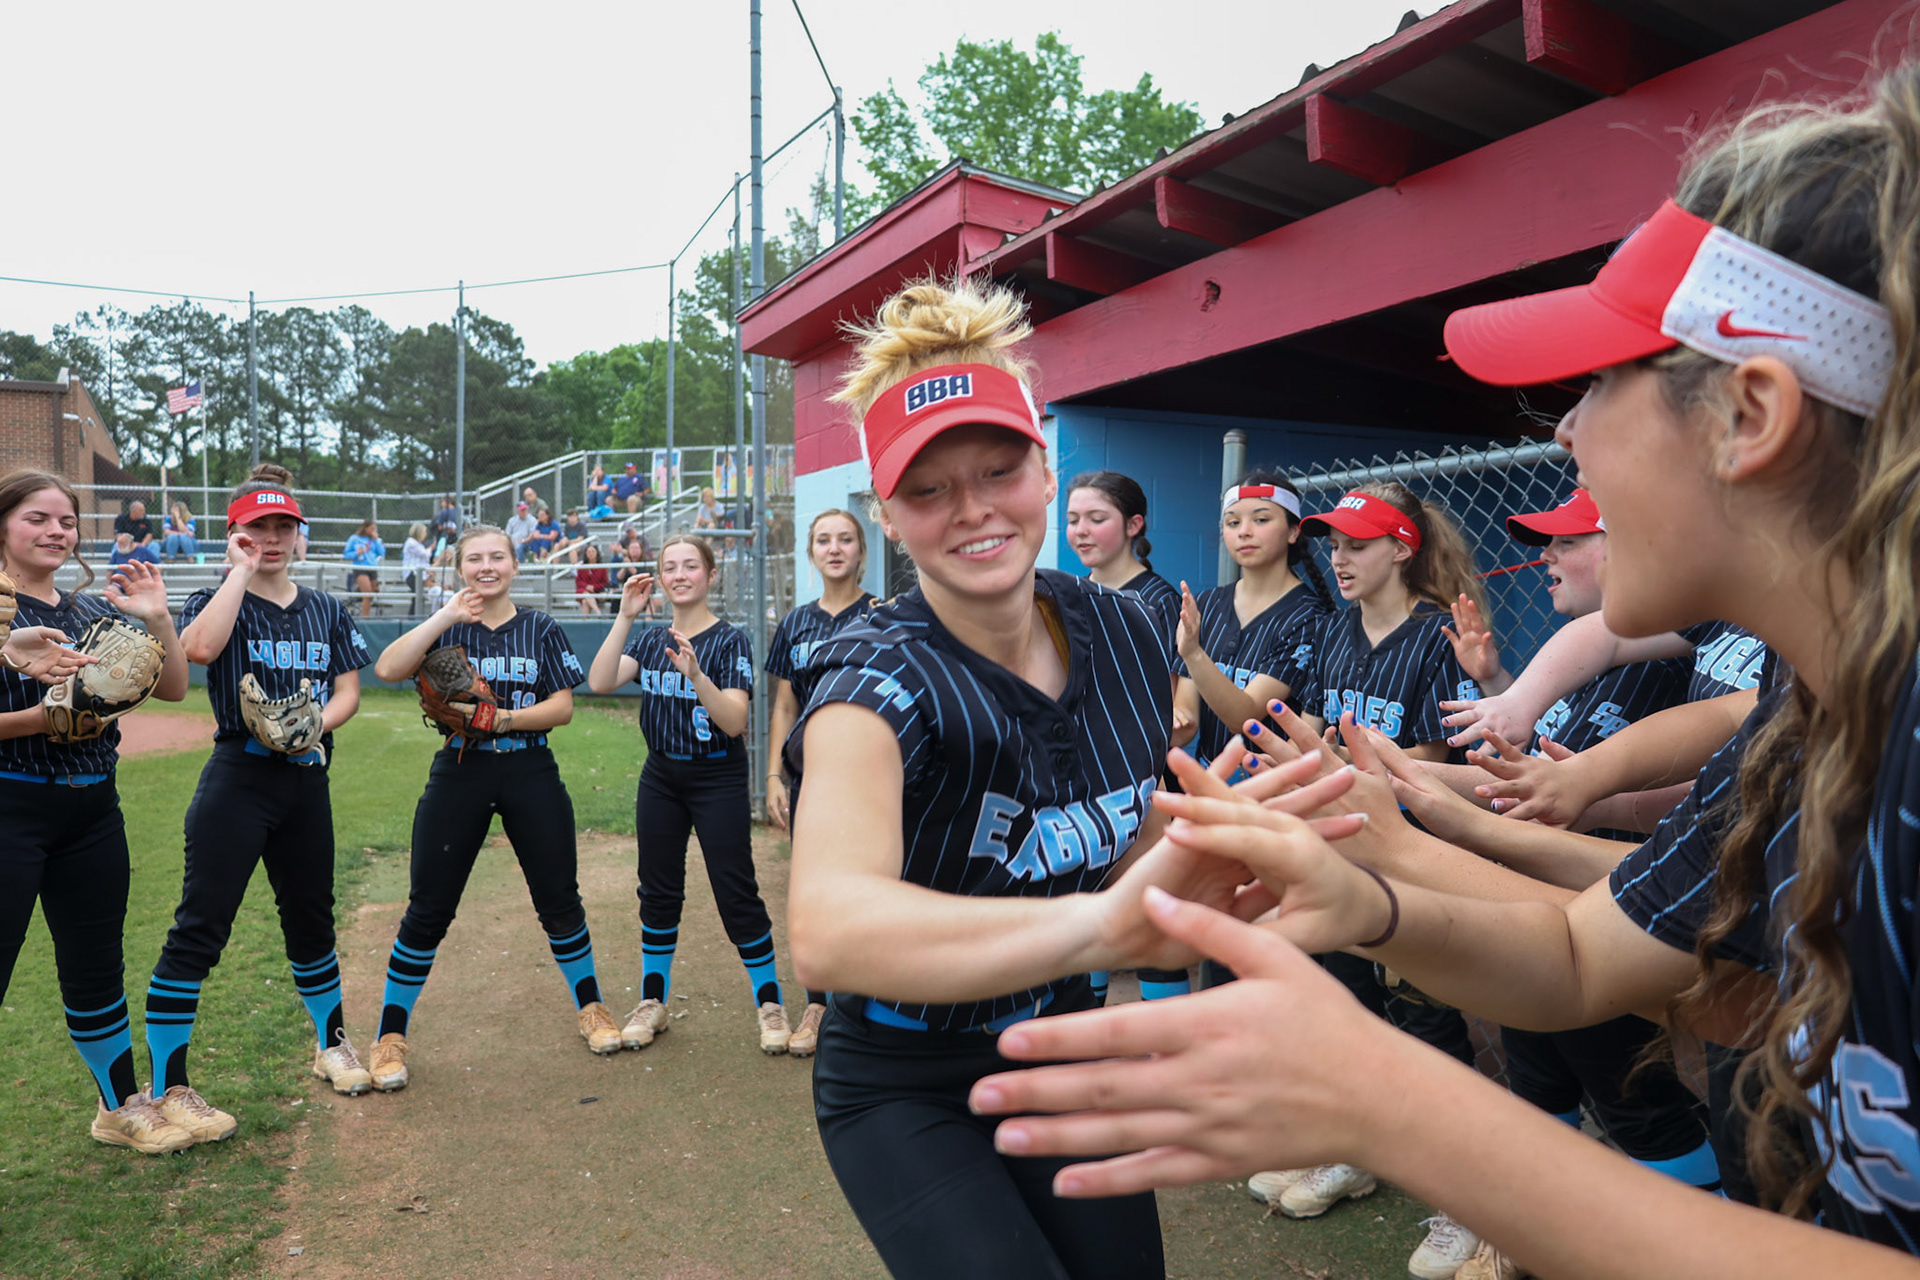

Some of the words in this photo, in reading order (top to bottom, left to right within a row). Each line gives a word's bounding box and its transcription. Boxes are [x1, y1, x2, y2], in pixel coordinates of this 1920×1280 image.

[905, 373, 973, 416] SBA
[257, 493, 286, 505] SBA
[467, 656, 538, 684] GLES
[641, 667, 698, 699] EAGLE
